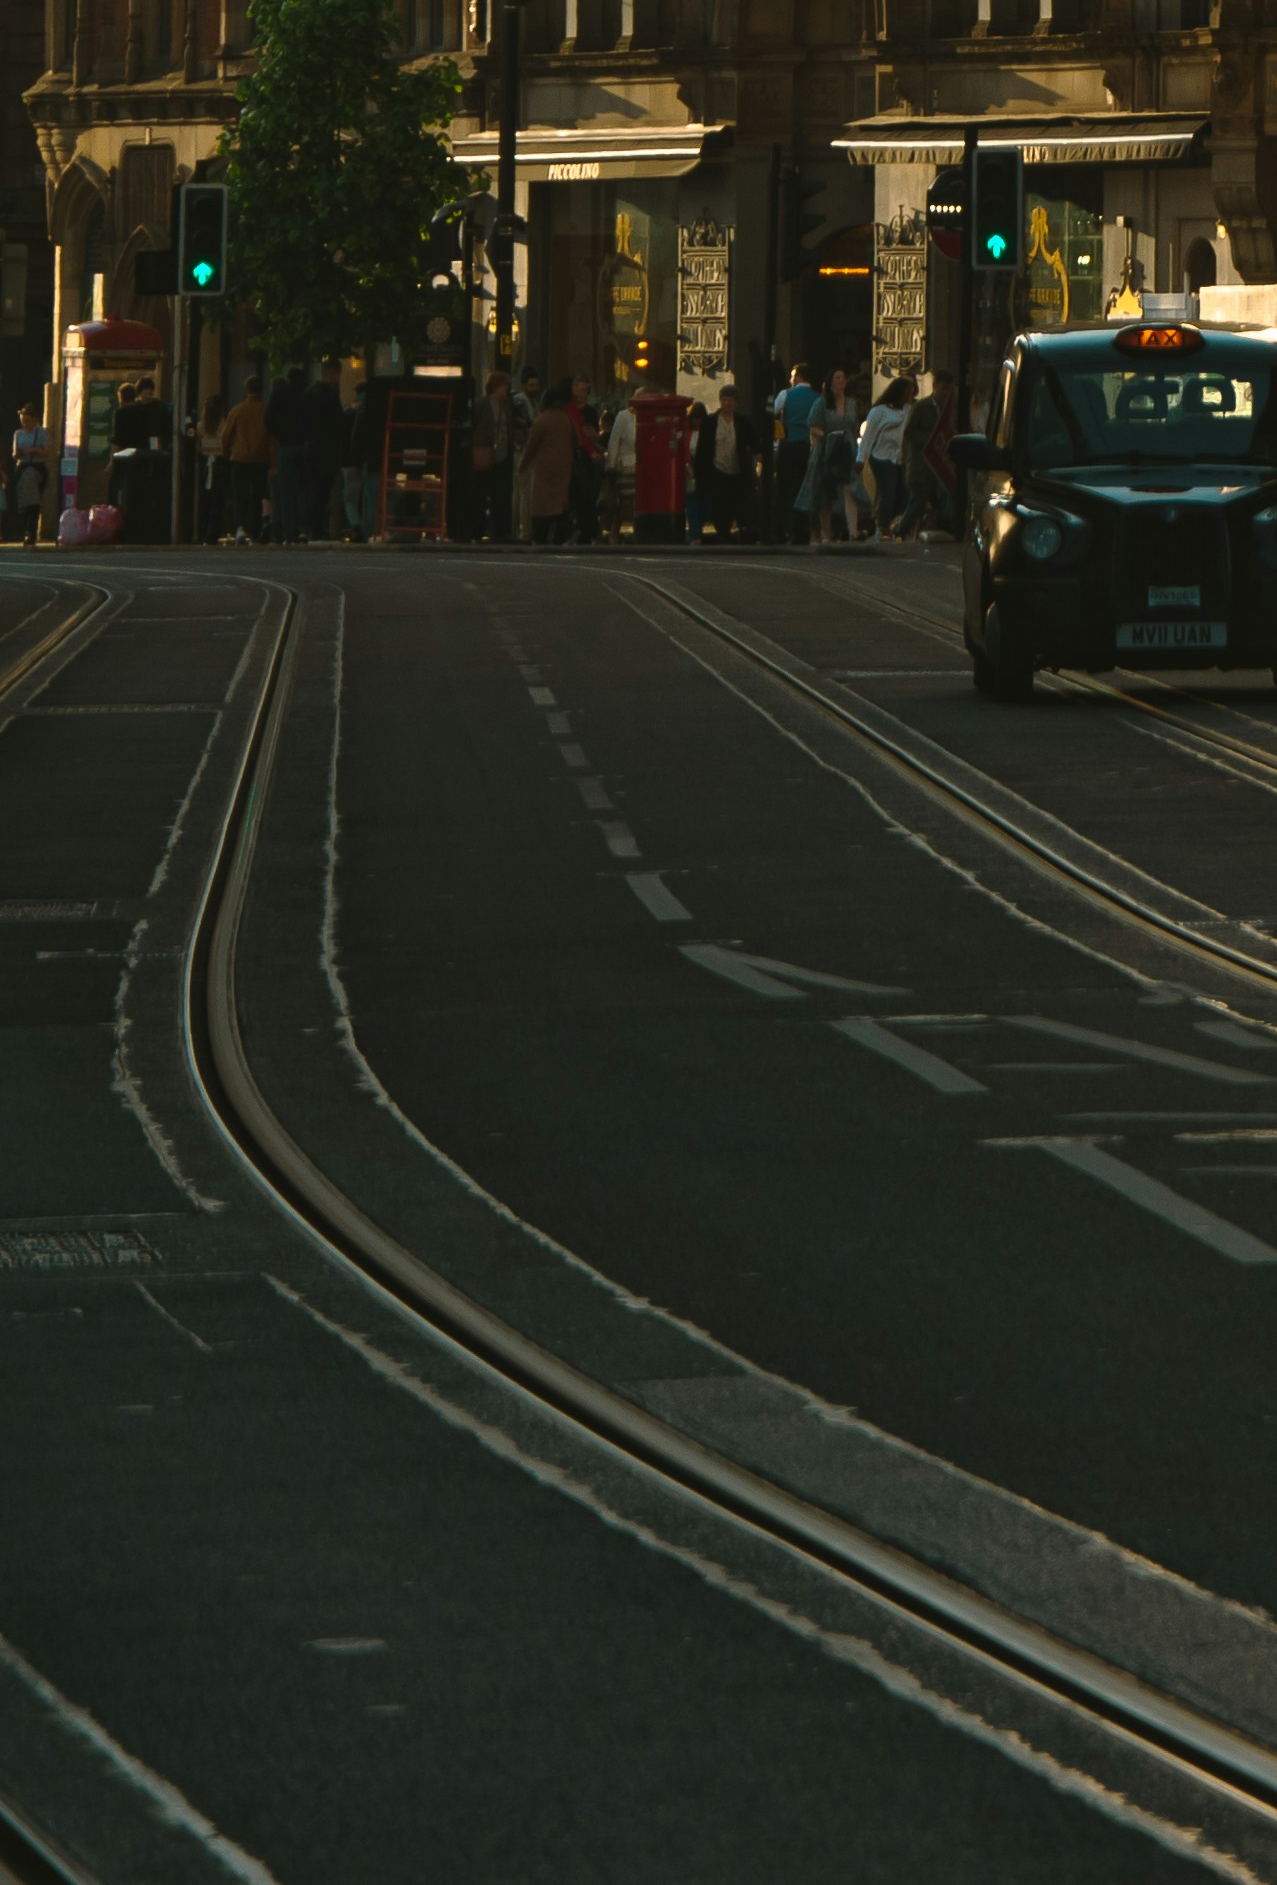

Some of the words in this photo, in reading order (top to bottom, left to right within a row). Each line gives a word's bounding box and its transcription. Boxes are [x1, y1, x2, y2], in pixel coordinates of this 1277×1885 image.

[548, 162, 600, 180] PICCOLINO
[1135, 329, 1185, 345] TAXI
[1174, 625, 1211, 644] UAN
